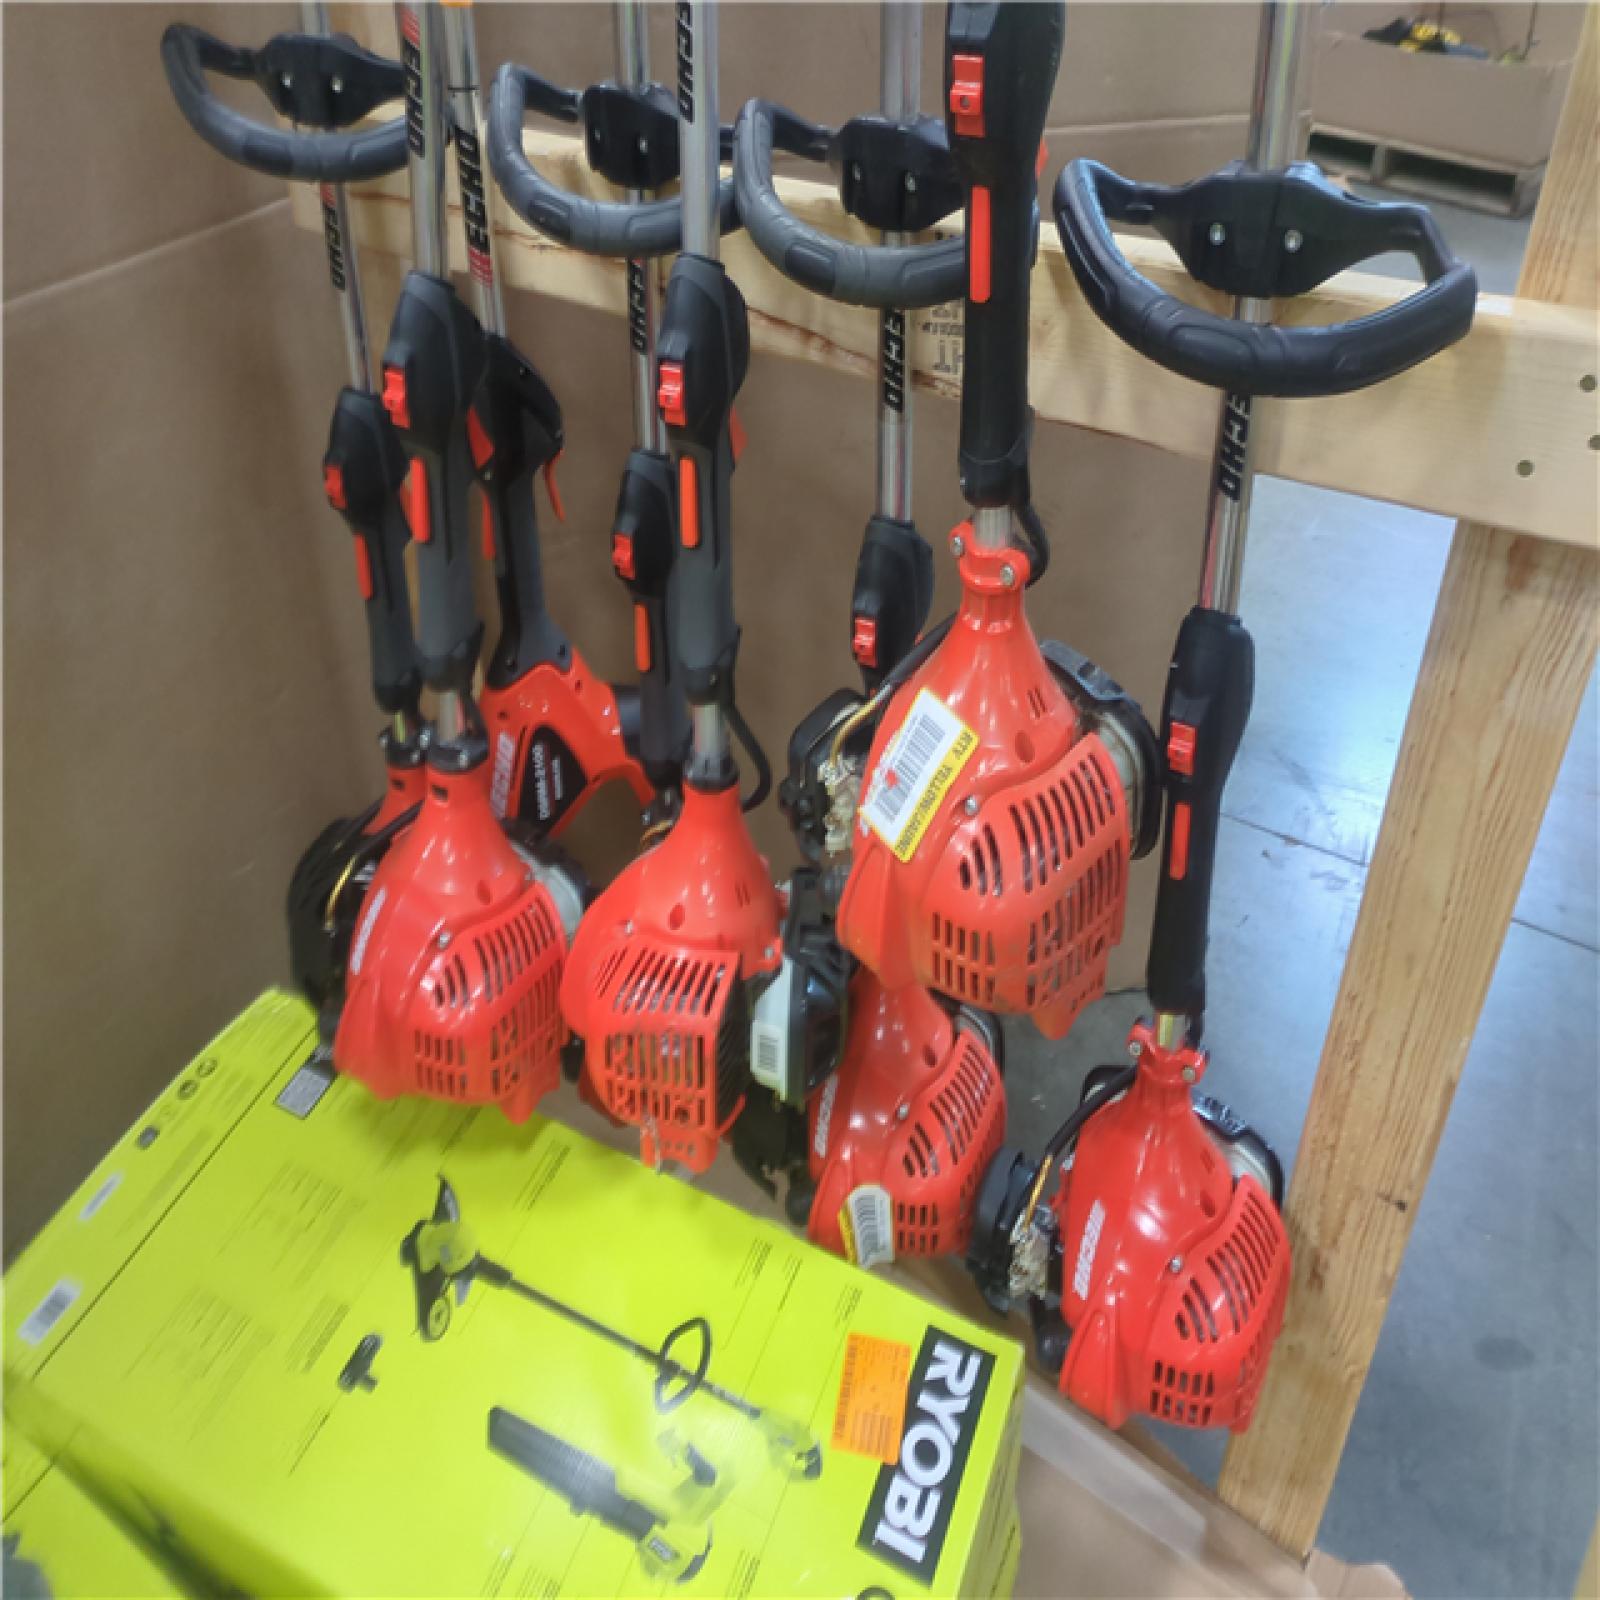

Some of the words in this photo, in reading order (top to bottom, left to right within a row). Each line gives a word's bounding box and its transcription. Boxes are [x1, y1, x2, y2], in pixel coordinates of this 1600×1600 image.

[402, 38, 425, 157] ECHO
[454, 125, 490, 256] ECHO
[630, 264, 648, 355] ECHO
[873, 1340, 984, 1562] RYOBI
